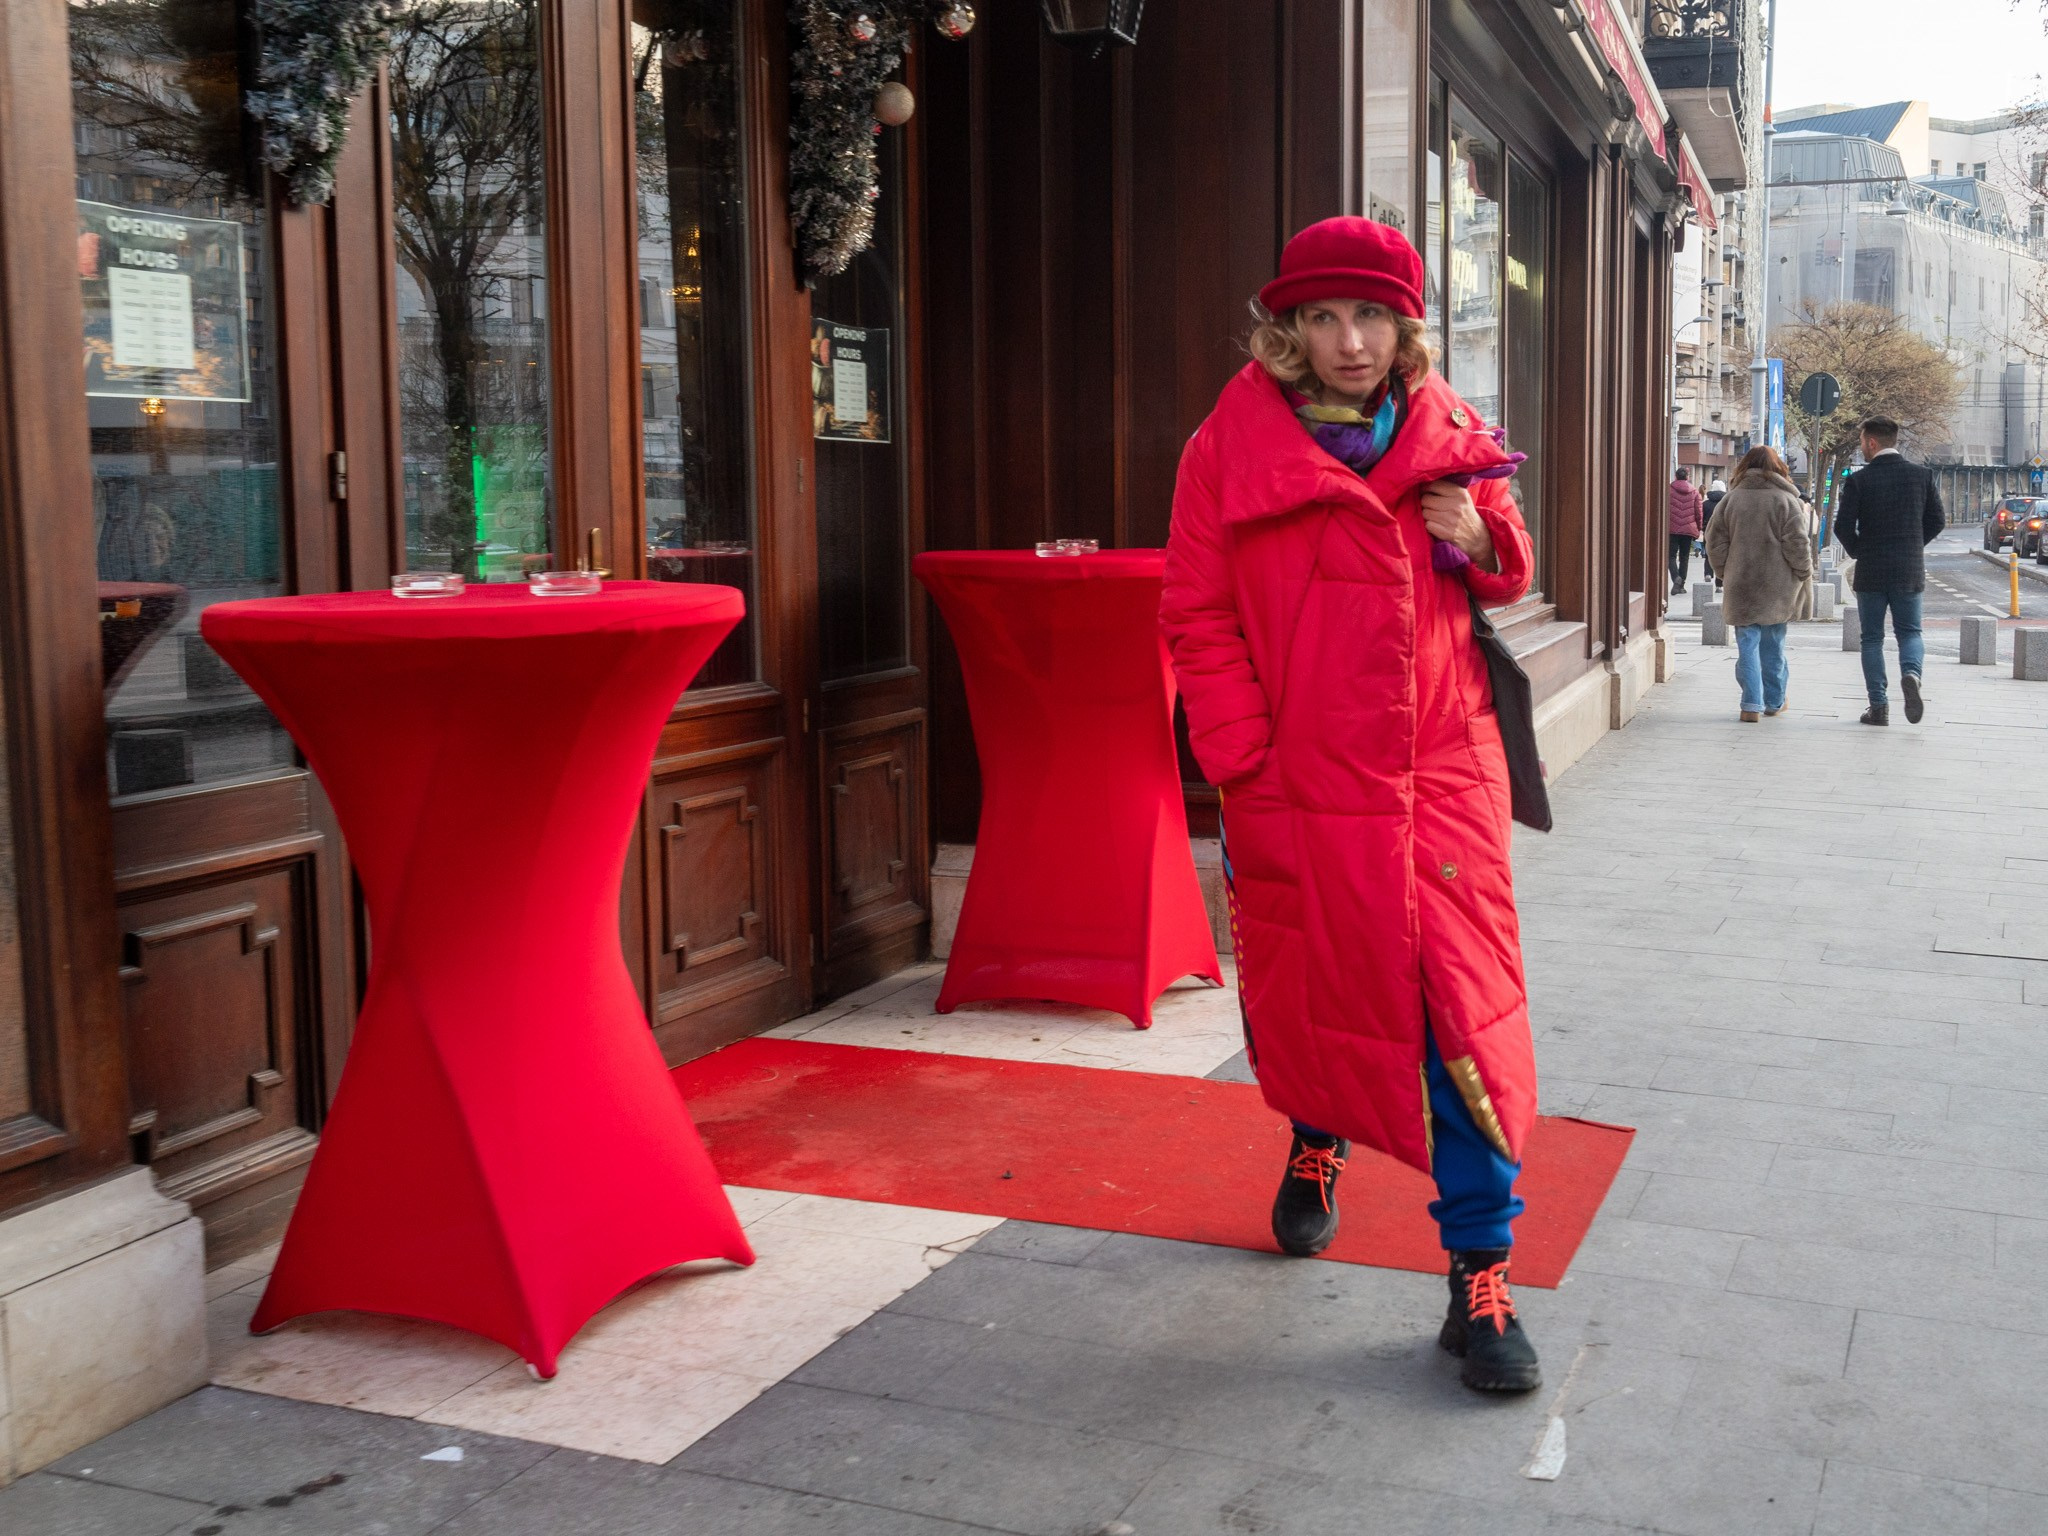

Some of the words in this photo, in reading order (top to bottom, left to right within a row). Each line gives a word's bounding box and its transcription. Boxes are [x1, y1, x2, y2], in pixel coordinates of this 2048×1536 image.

[106, 215, 187, 240] OPENING
[119, 247, 178, 270] HOURS
[833, 327, 866, 341] OPENING
[837, 347, 861, 360] HOURS
